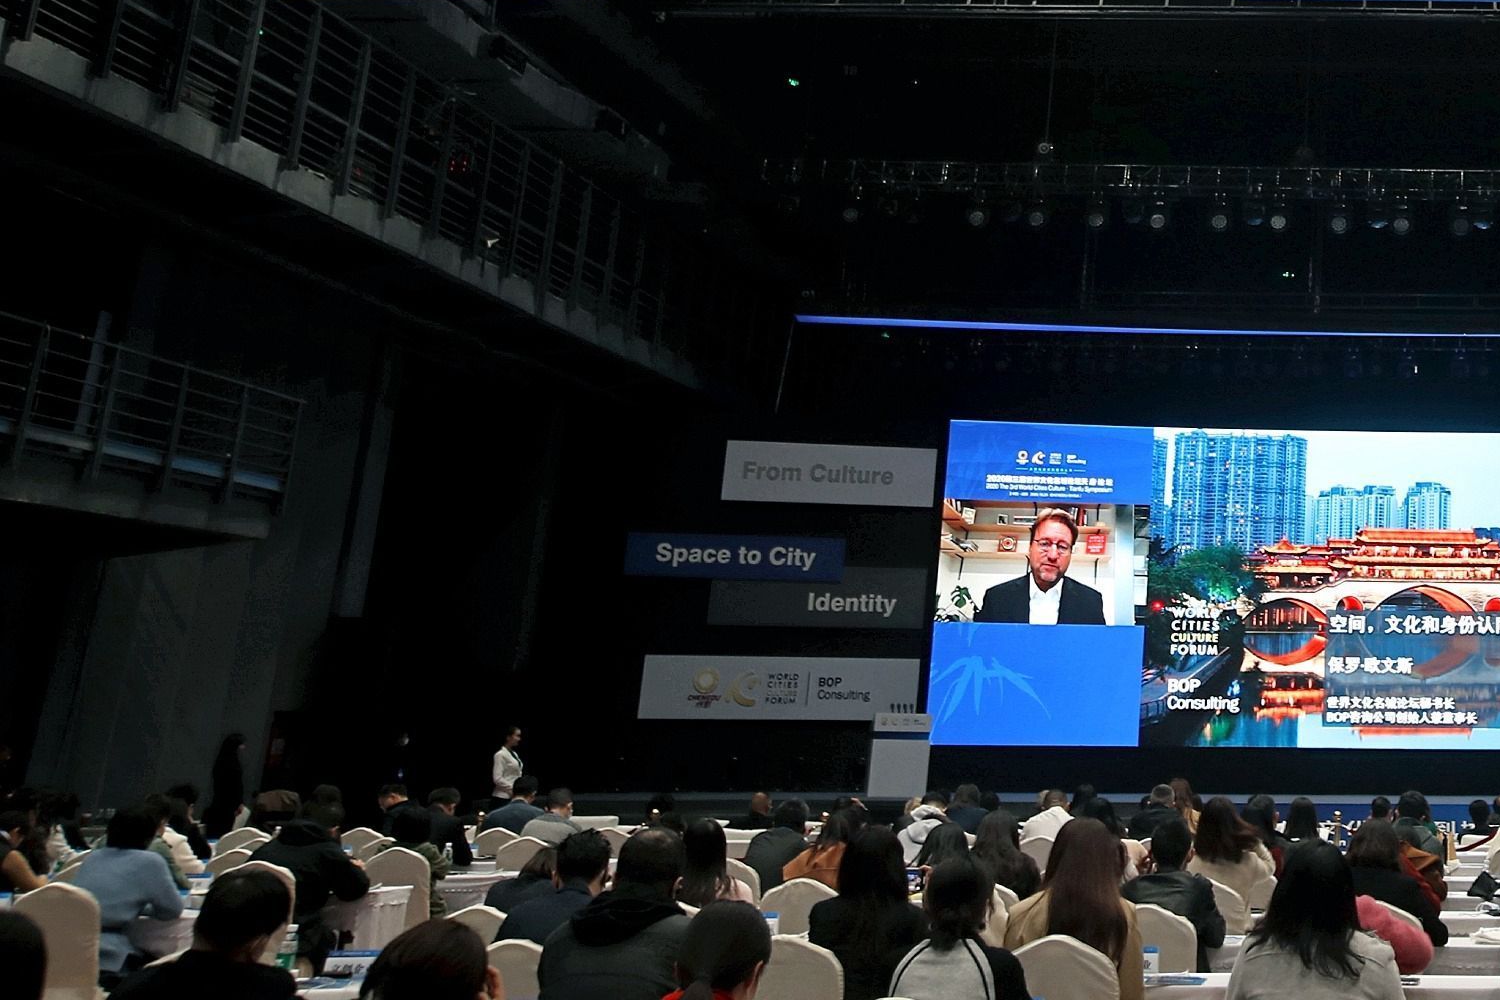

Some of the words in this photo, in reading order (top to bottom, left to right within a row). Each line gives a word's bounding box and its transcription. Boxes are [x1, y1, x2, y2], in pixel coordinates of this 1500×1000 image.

[742, 461, 802, 483] From
[810, 464, 894, 486] Culture
[655, 542, 731, 567] Space
[739, 546, 761, 565] to
[769, 546, 817, 571] City
[807, 592, 897, 618] Identity
[1172, 607, 1220, 619] WORLD
[1171, 620, 1220, 632] CITIES
[1170, 632, 1219, 643] CULTURE
[1170, 644, 1219, 656] FORUM
[767, 673, 800, 682] WORLD
[818, 676, 843, 688] BOP
[767, 681, 799, 690] CITIES
[1167, 678, 1202, 693] BOP
[765, 696, 797, 706] FORUM
[817, 688, 871, 703] Consulting
[1166, 695, 1240, 713] Consulting
